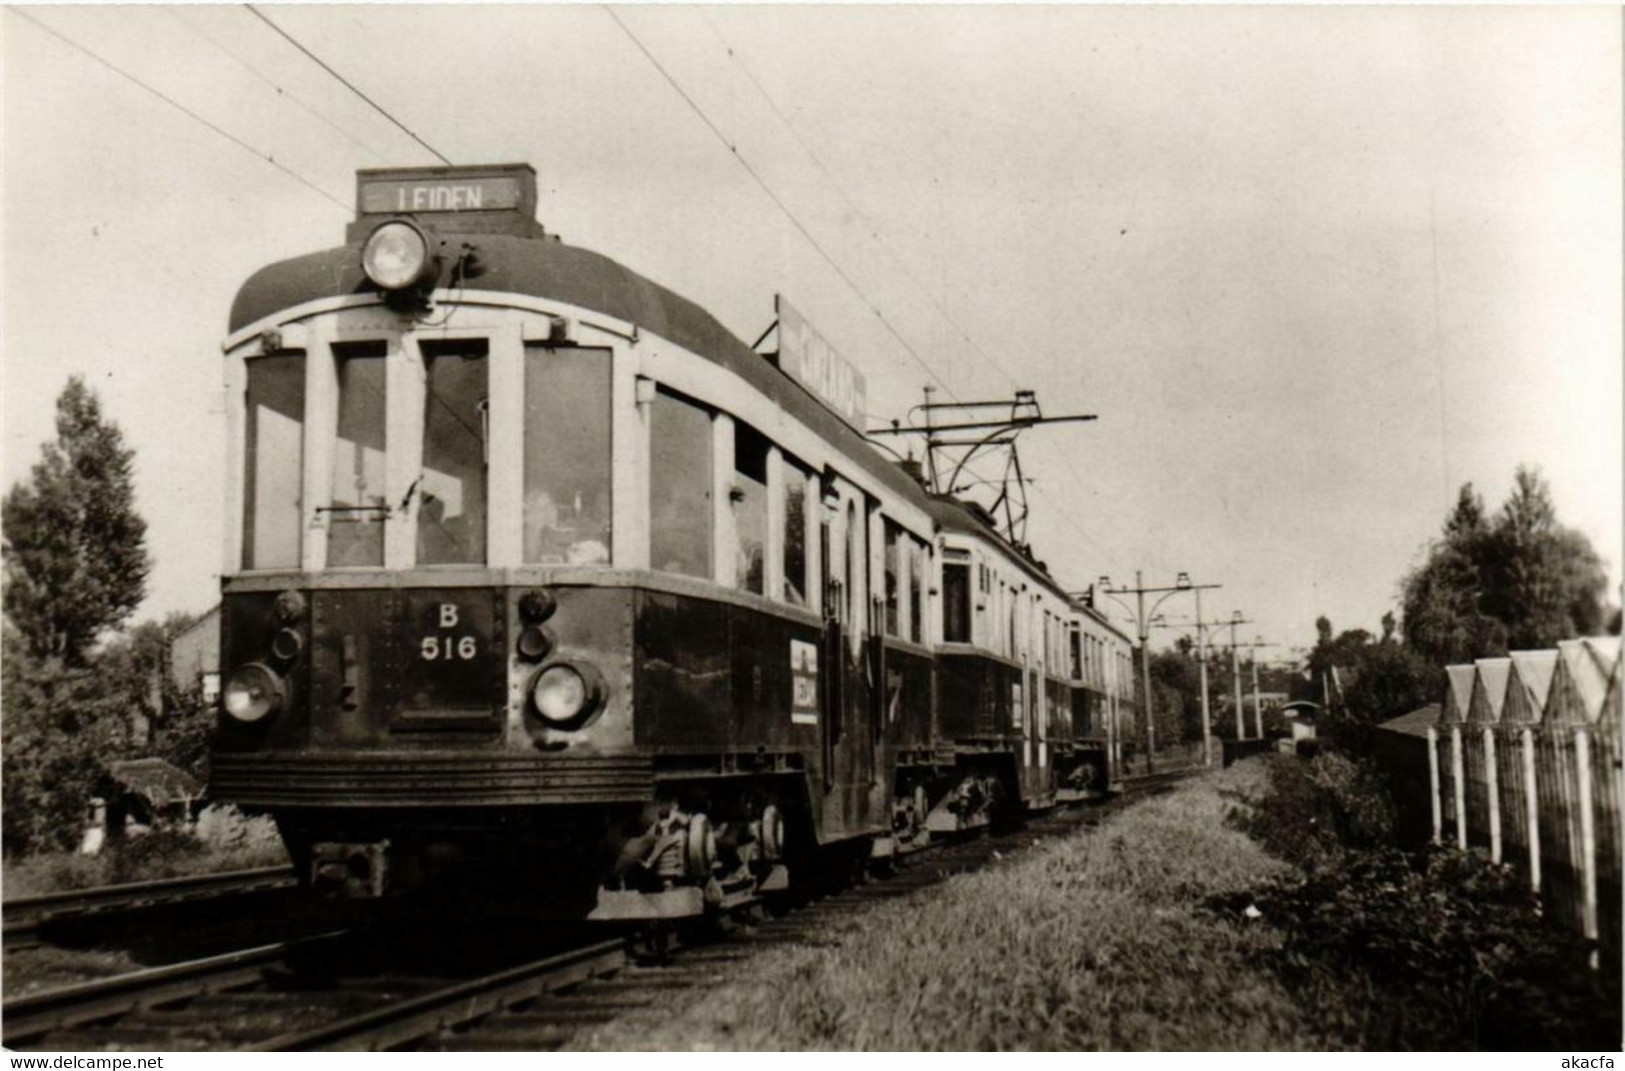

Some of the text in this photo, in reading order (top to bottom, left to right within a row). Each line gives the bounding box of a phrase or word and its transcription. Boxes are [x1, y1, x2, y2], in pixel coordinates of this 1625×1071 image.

[397, 185, 483, 211] LEIDEN
[440, 604, 458, 627] B
[420, 636, 476, 660] 516
